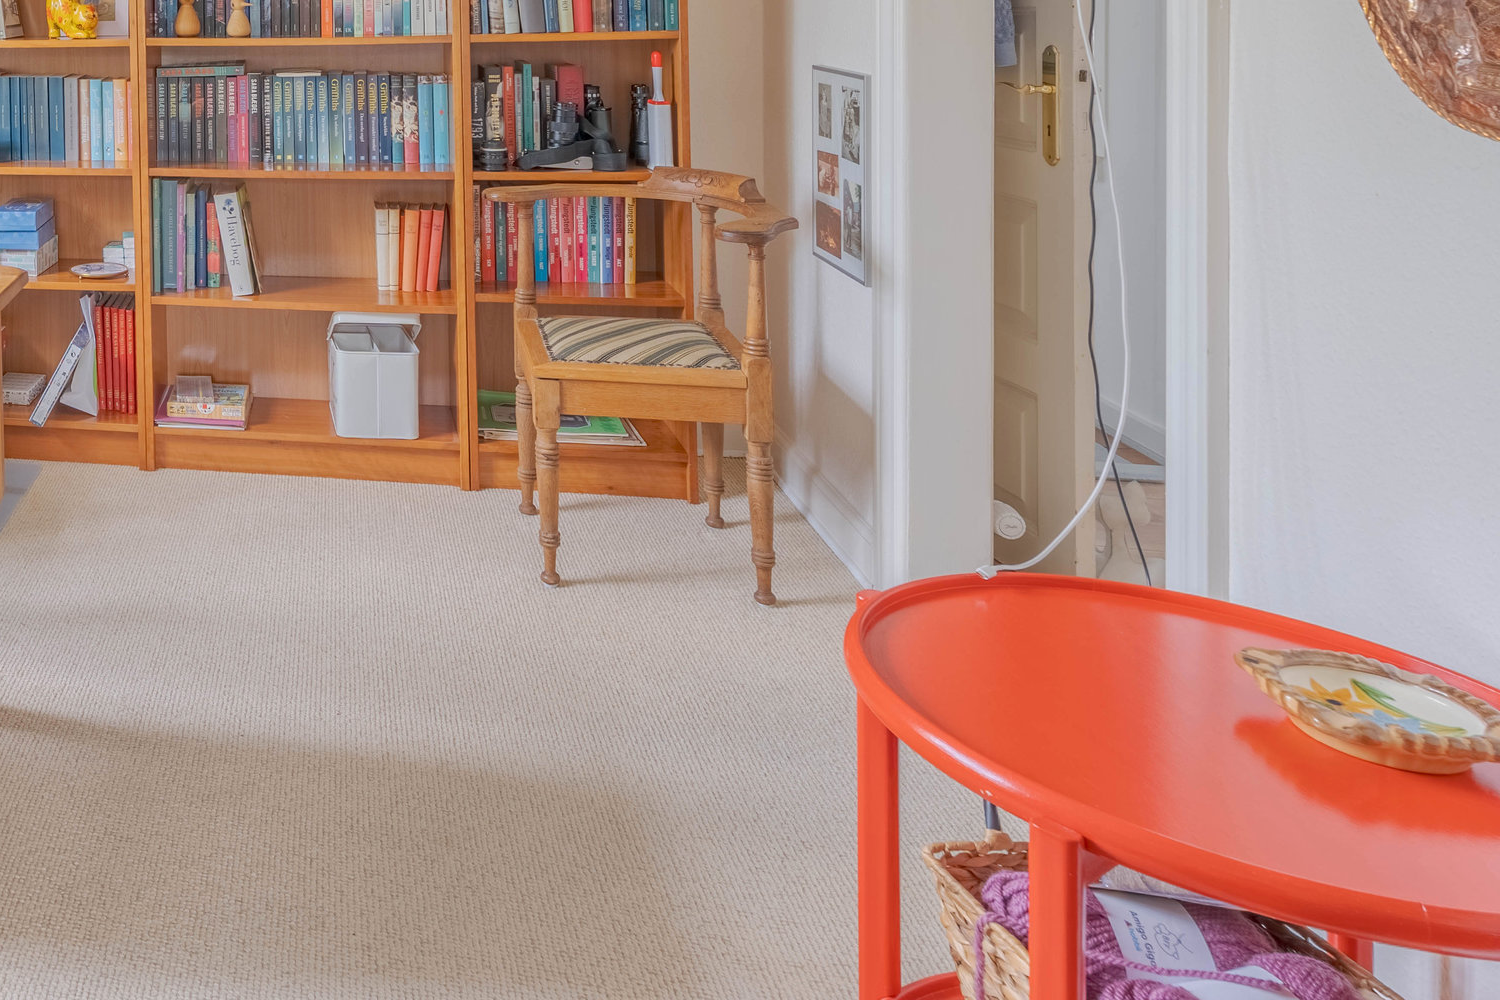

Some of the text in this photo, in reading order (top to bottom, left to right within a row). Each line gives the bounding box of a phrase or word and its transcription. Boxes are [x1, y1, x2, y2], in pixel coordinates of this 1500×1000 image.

[274, 81, 282, 112] Griffiths
[284, 81, 293, 113] Griffiths
[307, 81, 315, 111] Griffiths
[319, 81, 327, 112] Griffiths
[331, 79, 339, 111] Griffiths
[345, 84, 353, 115] Griffiths
[357, 79, 365, 111] Griffiths
[368, 83, 377, 114] Griffiths
[380, 83, 389, 114] Griffiths
[472, 118, 484, 139] 1793
[507, 202, 516, 233] Jungstedt
[562, 203, 571, 234] Jungstedt
[576, 205, 584, 234] Jungstedt
[589, 205, 597, 234] Jungstedt
[603, 203, 611, 234] Jungstedt
[615, 203, 623, 234] Jungstedt
[627, 204, 635, 234] Jungstedt
[226, 216, 241, 266] Havebog
[1129, 910, 1157, 967] Amigo Gigo
